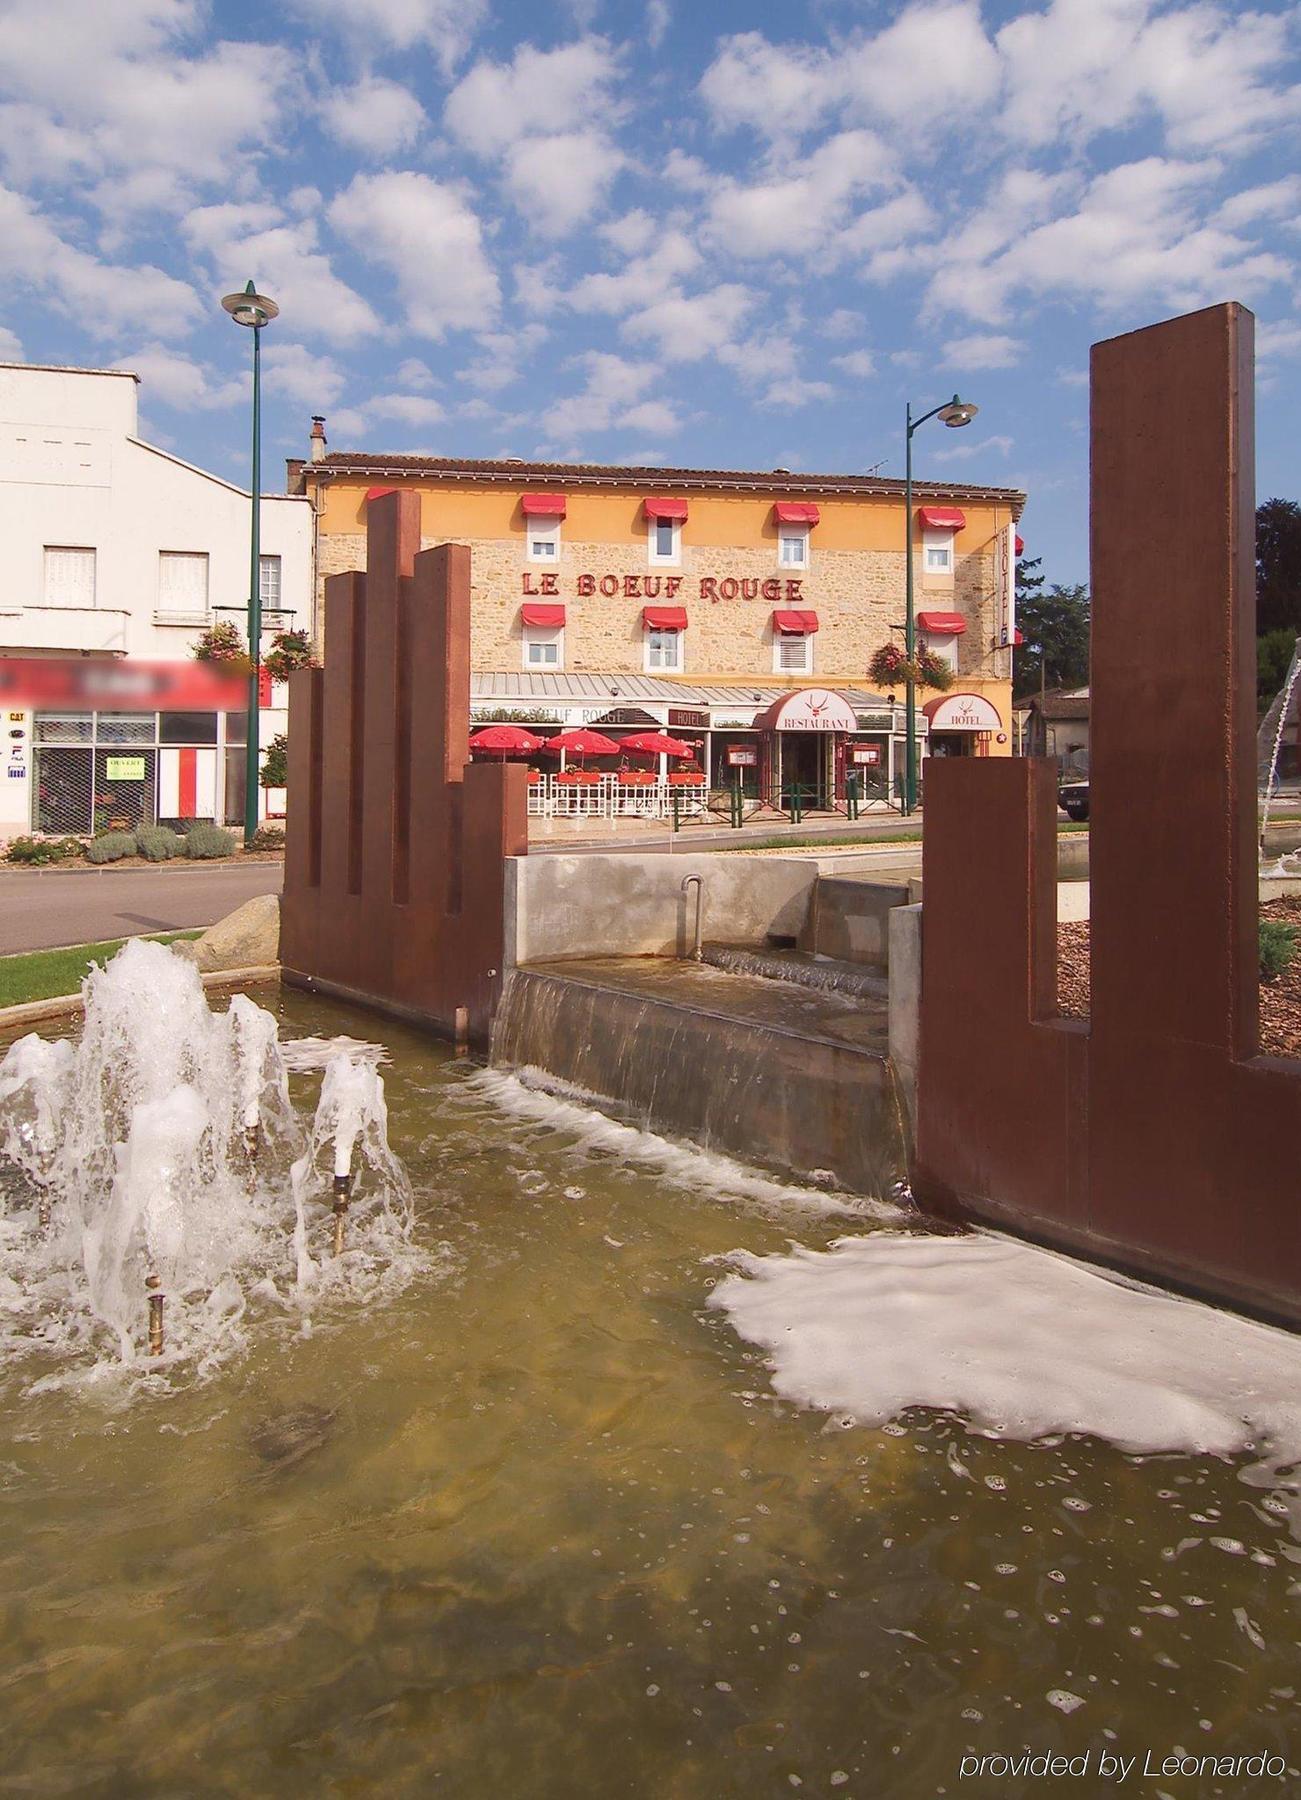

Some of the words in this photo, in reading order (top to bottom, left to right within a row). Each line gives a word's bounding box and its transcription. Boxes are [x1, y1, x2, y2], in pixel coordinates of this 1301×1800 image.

[522, 573, 560, 596] LE
[577, 574, 683, 598] BOEUF
[700, 577, 805, 604] ROUGE
[10, 713, 24, 721] CAT
[582, 709, 624, 723] ROUGE
[677, 712, 701, 725] HOTEL
[951, 716, 982, 725] HOTEL
[784, 718, 849, 729] RESTAURANT
